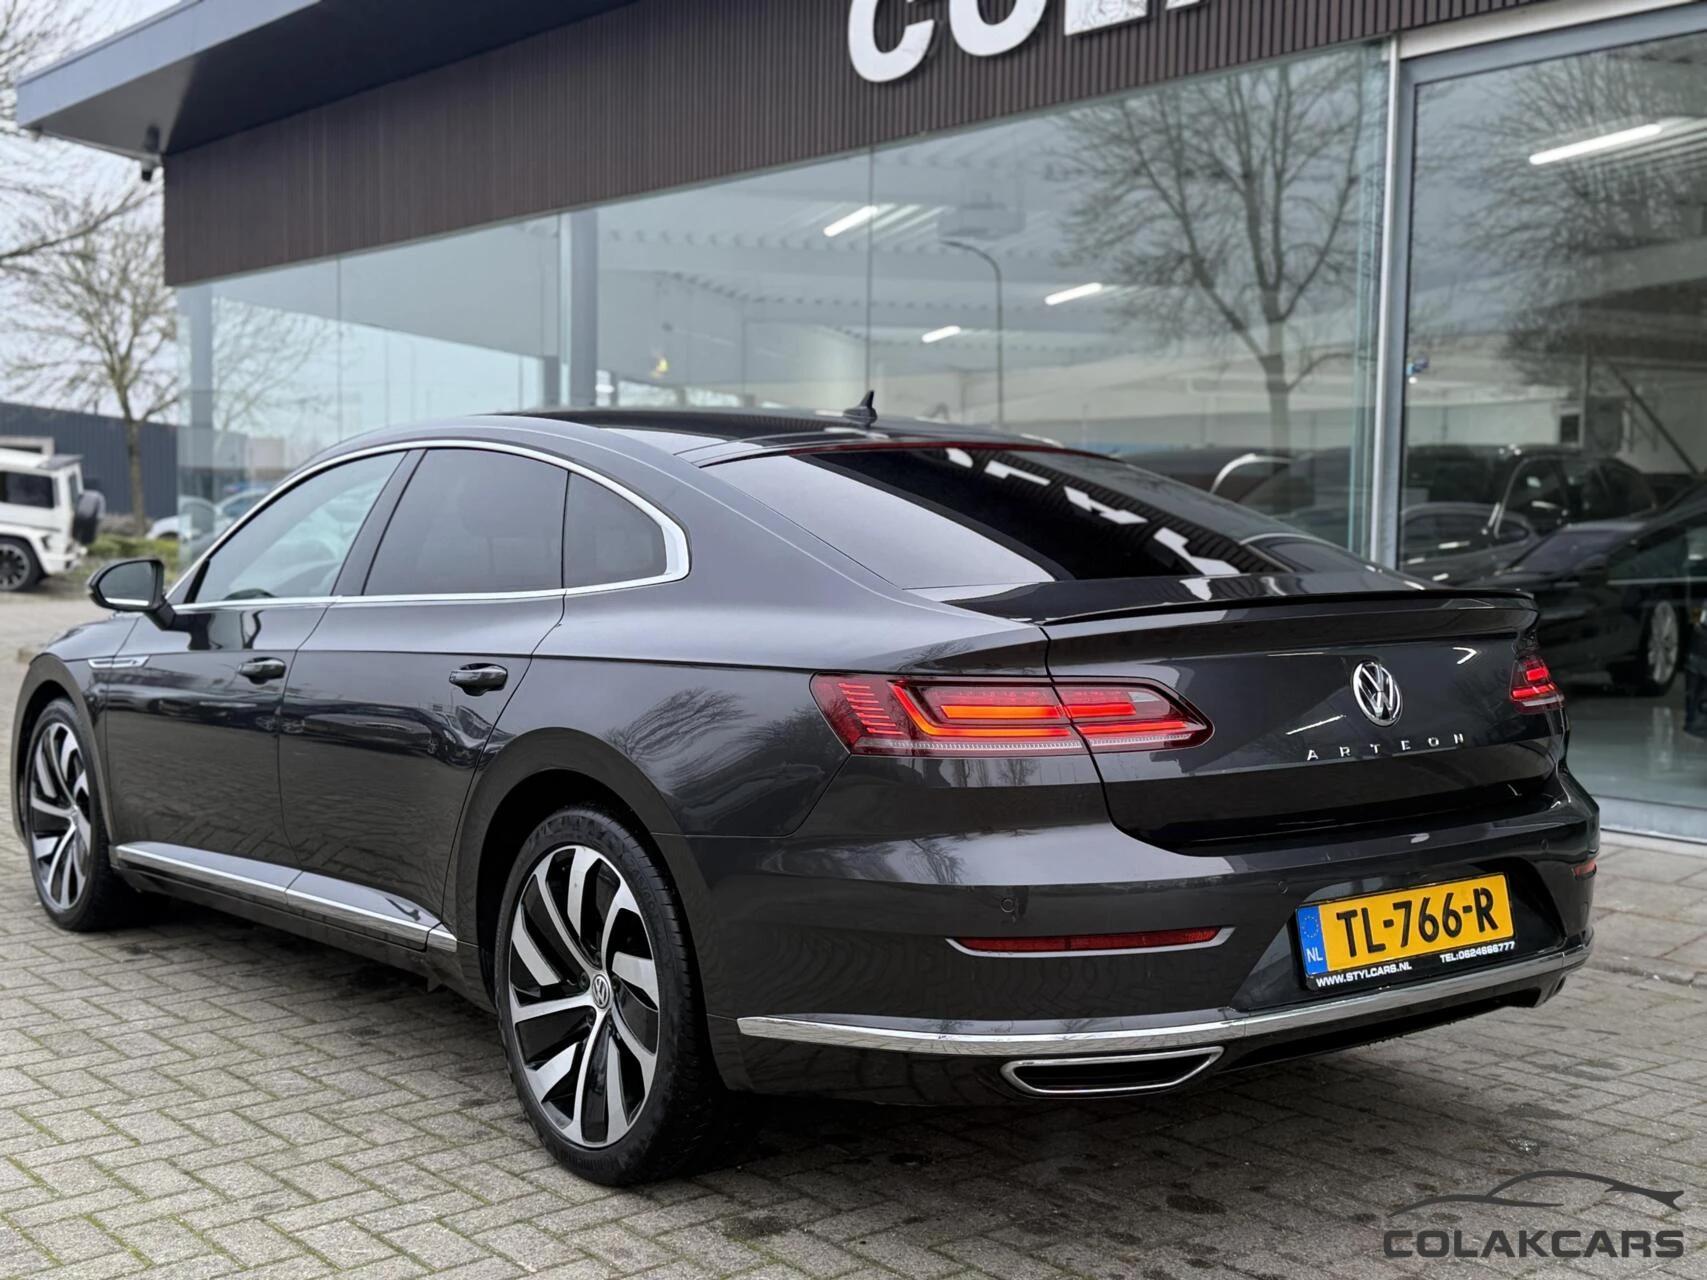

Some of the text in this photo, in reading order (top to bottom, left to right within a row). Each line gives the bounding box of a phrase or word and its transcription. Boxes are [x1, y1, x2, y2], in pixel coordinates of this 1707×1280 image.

[1306, 733, 1465, 762] ARTEON
[1336, 887, 1499, 958] TL-766-R
[1306, 946, 1324, 963] NL
[1316, 961, 1413, 988] WWW.STYLCARS.NL
